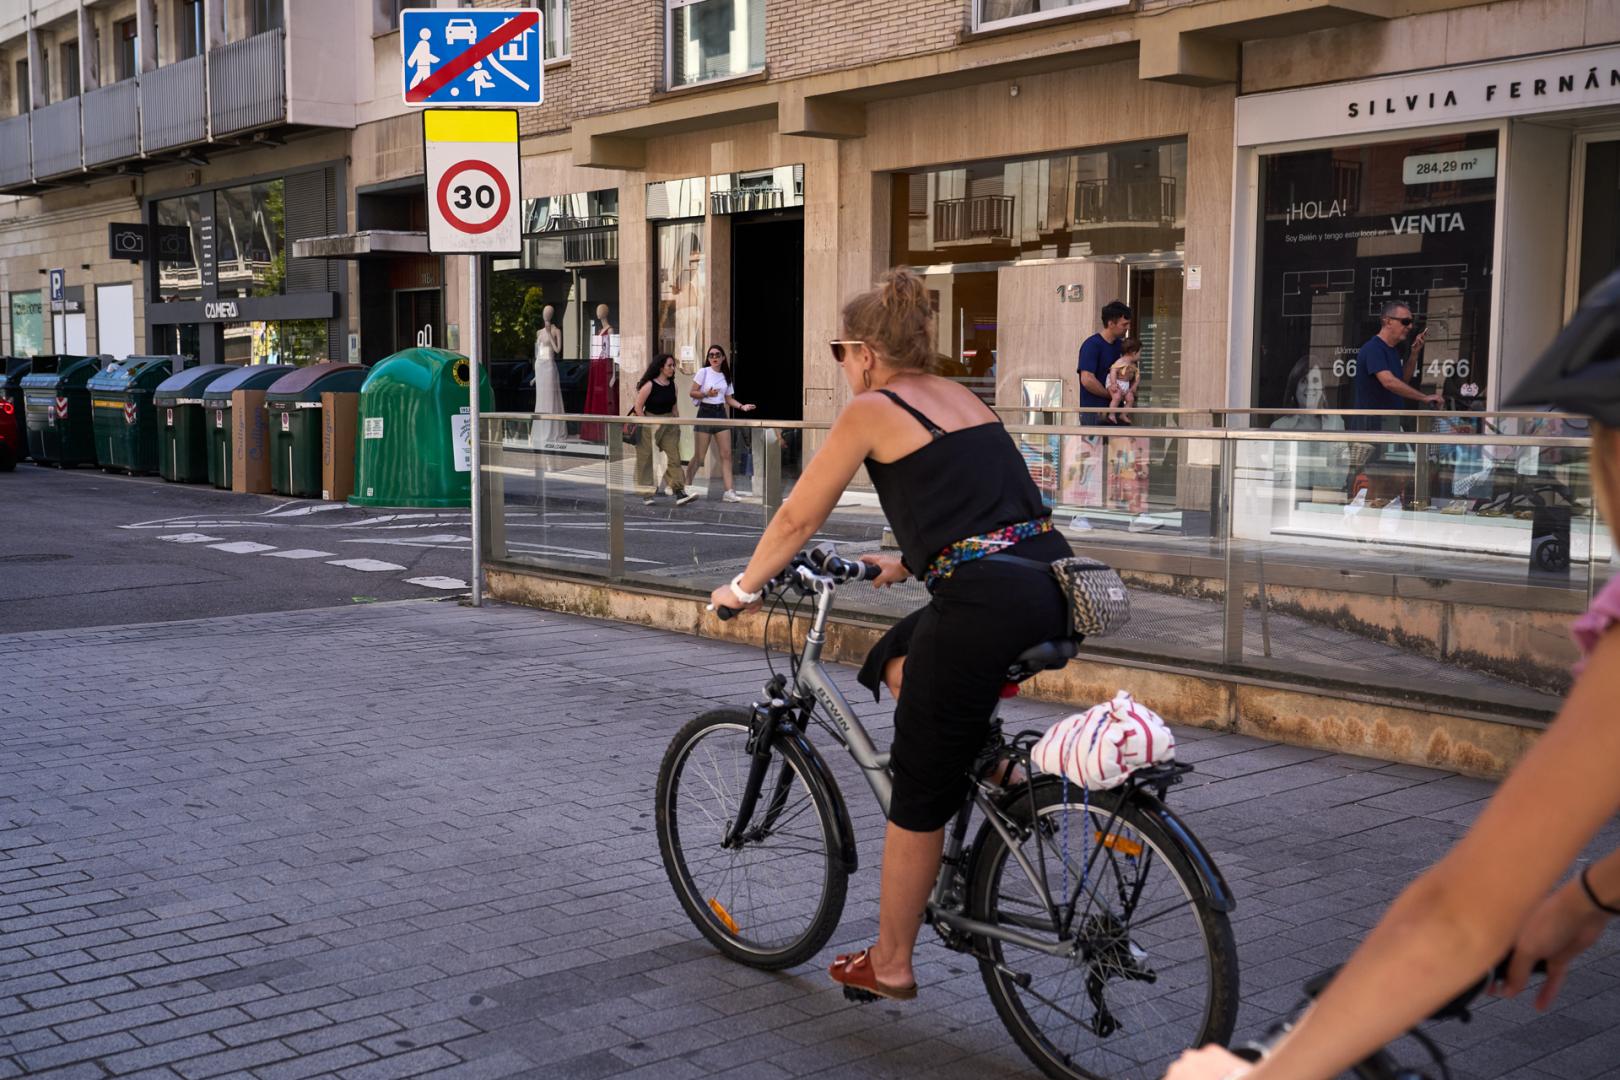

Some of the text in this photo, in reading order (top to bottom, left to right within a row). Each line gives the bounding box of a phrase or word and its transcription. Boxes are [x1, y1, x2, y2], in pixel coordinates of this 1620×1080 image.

[1348, 90, 1457, 118] SILVIA
[1416, 160, 1458, 176] 284,29
[453, 185, 495, 210] 30
[1286, 199, 1347, 226] ¡HOLA!
[1285, 234, 1297, 243] Soy
[1318, 234, 1323, 242] y
[1324, 232, 1343, 241] tengo
[1390, 212, 1465, 235] VENTA
[52, 273, 61, 298] P
[1056, 284, 1084, 303] 13
[205, 301, 239, 319] CAMERA
[1427, 359, 1470, 378] 466
